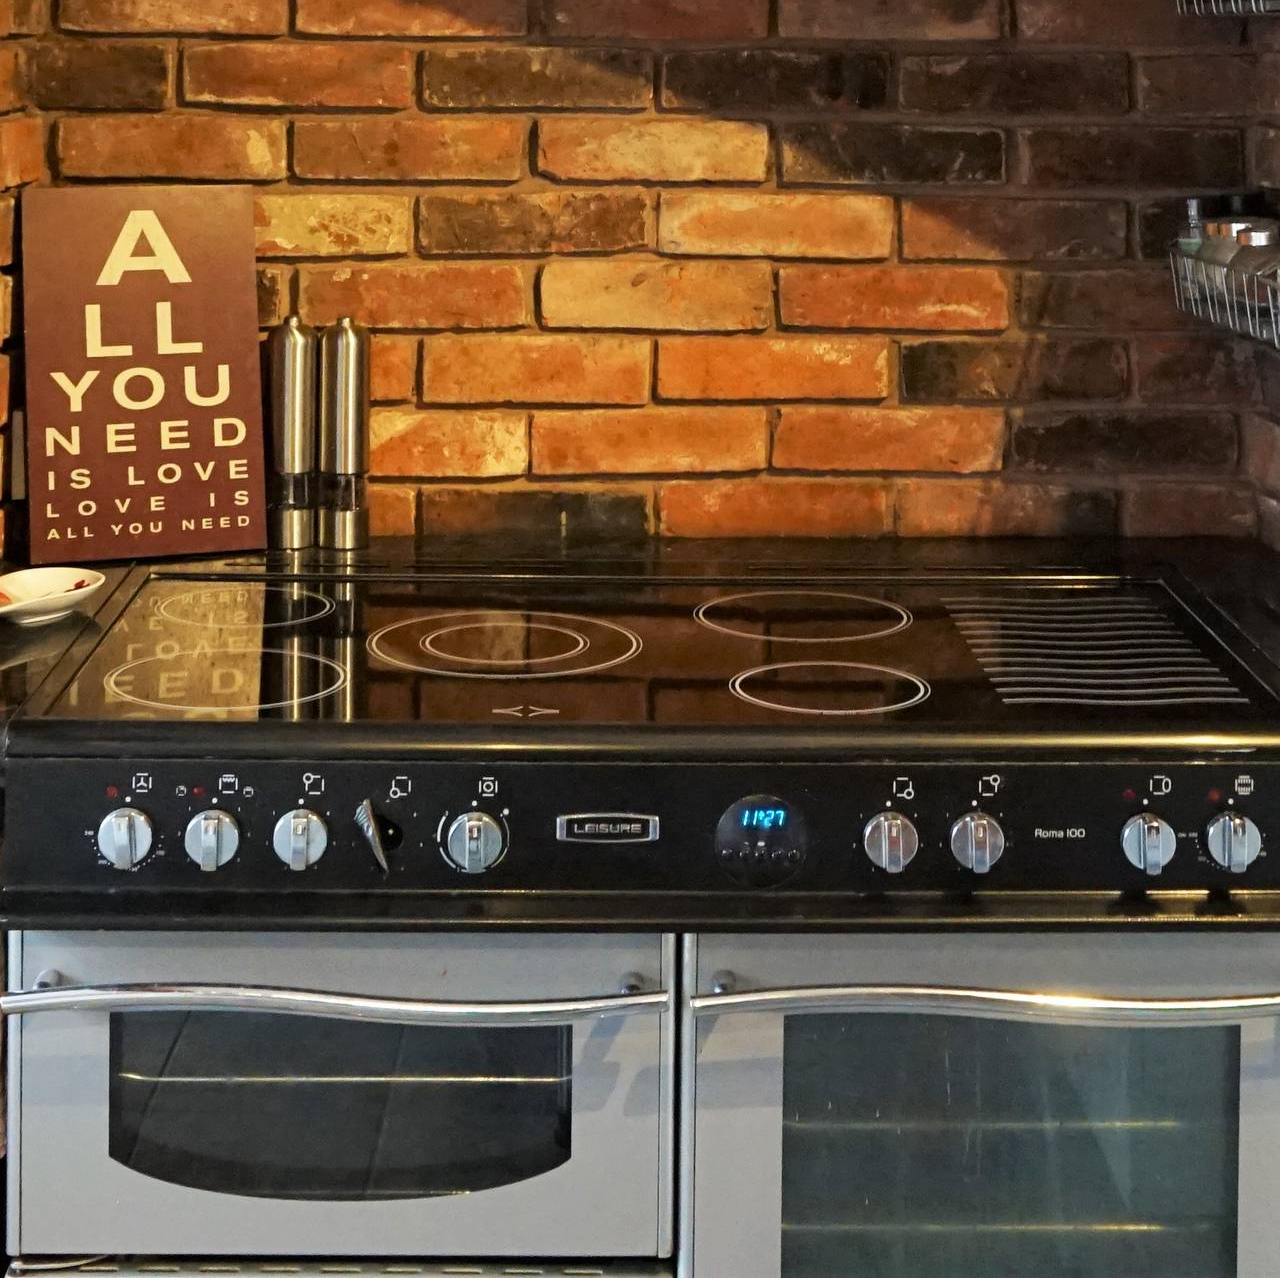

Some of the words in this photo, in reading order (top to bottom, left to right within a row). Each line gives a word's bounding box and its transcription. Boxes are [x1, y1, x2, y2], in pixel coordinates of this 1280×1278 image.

[95, 209, 193, 286] A
[84, 301, 203, 358] LL
[49, 363, 231, 412] YOU
[45, 417, 247, 457] NEED
[47, 467, 92, 491] IS
[127, 459, 249, 487] LOVE
[46, 495, 166, 519] LOVE
[208, 490, 250, 507] IS
[46, 526, 95, 541] ALL
[110, 521, 164, 537] YOU
[181, 514, 251, 531] NEED
[573, 823, 642, 834] LEISURE
[740, 809, 785, 828] 11:27
[1034, 828, 1064, 838] Roma
[1066, 828, 1086, 838] 100
